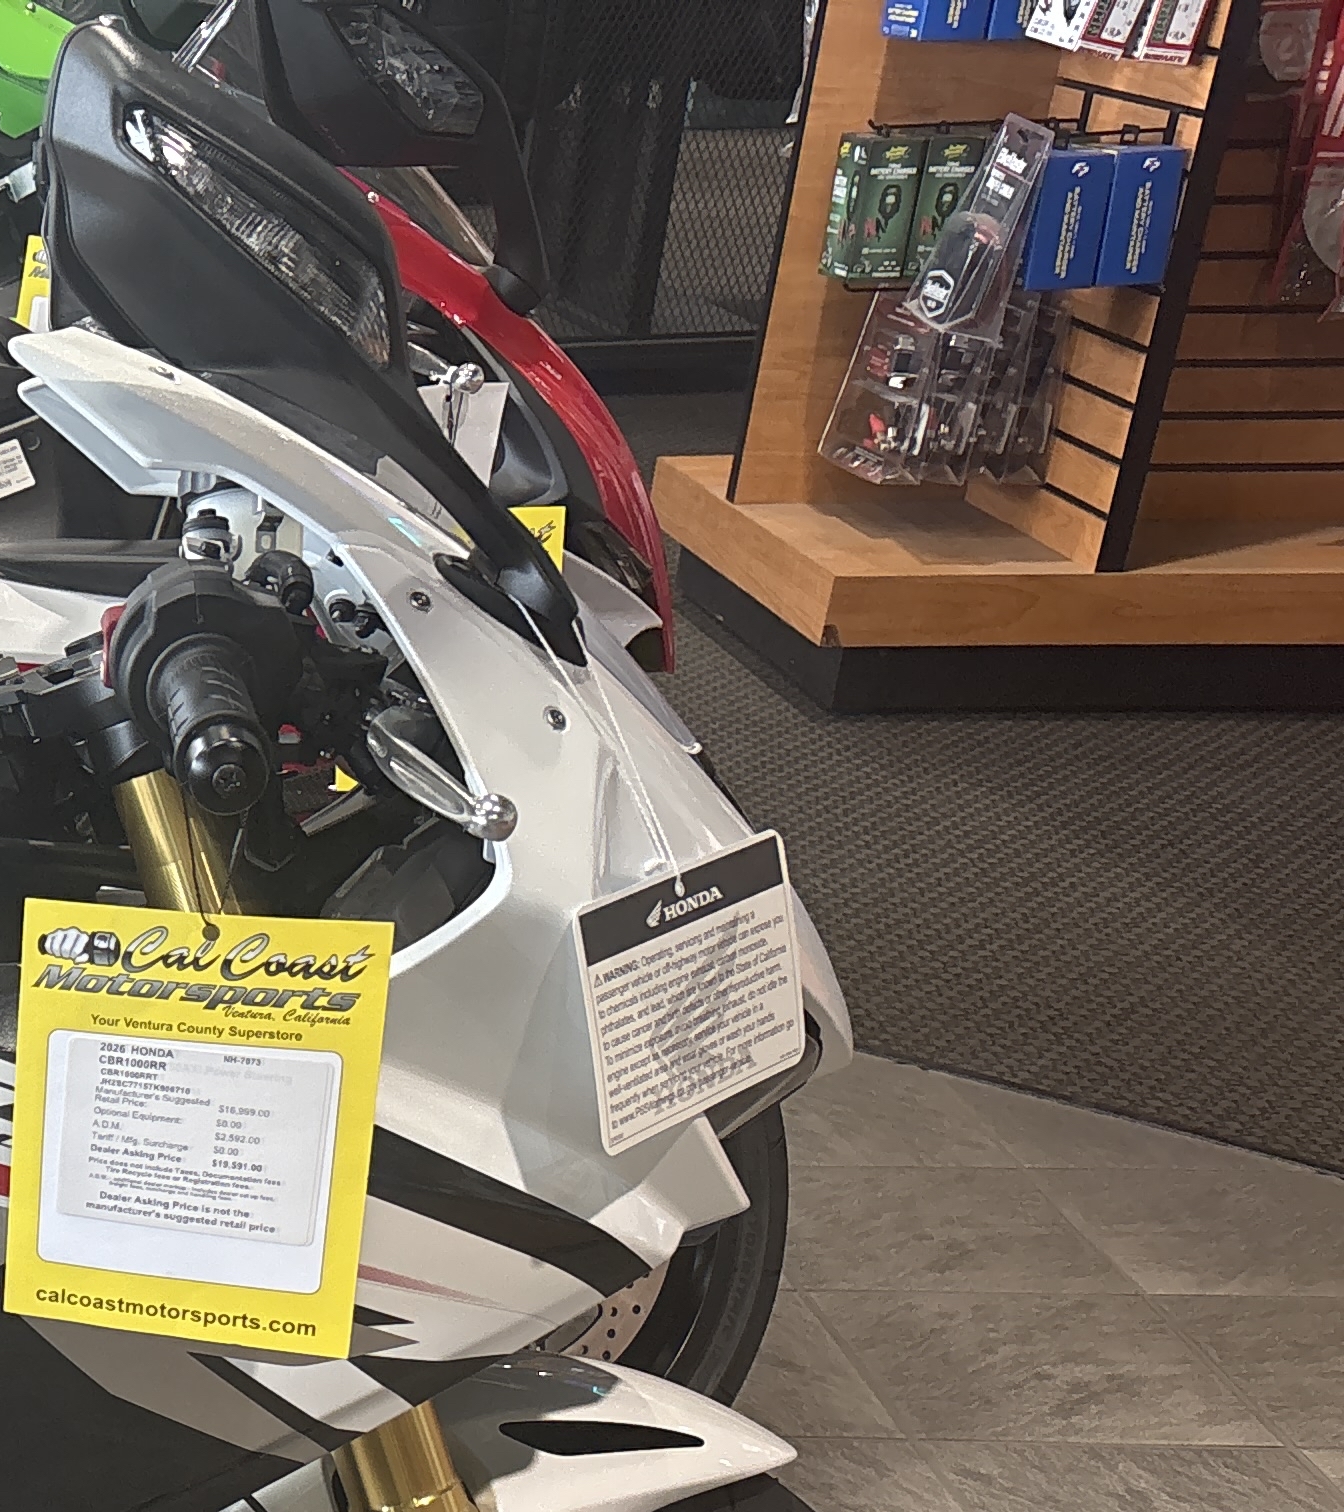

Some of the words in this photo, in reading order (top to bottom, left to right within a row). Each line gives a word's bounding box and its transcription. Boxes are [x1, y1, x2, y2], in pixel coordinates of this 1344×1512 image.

[663, 886, 724, 922] HONDA
[121, 926, 220, 974] Cal
[221, 932, 375, 982] Coast
[32, 962, 361, 1013] Motorsports
[595, 982, 630, 1005] passenger
[639, 983, 667, 1003] including
[283, 1008, 351, 1027] California
[91, 1013, 118, 1030] Your
[123, 1016, 173, 1033] Ventura
[177, 1021, 225, 1039] County
[228, 1024, 302, 1043] Superstore
[610, 1034, 630, 1048] cause
[631, 1024, 652, 1038] cancer
[99, 1042, 125, 1053] 2026
[130, 1045, 174, 1058] HONDA
[98, 1055, 166, 1070] CBR1000RR
[94, 1094, 119, 1104] Retail
[161, 1094, 210, 1107] Suggested
[93, 1106, 130, 1118] Optional
[215, 1119, 241, 1129] $0.00
[90, 1143, 119, 1154] Dealer
[122, 1147, 154, 1160] Asking
[157, 1153, 181, 1162] Price
[142, 1138, 188, 1152] Surcharge
[213, 1146, 239, 1156] $0.00
[88, 1156, 107, 1165] Price
[109, 1158, 128, 1167] does
[144, 1163, 173, 1173] include
[105, 1166, 120, 1174] Tire
[121, 1168, 152, 1179] Recycle
[99, 1190, 131, 1202] Dealer
[133, 1196, 169, 1210] Asking
[172, 1201, 198, 1212] Price
[200, 1205, 210, 1213] is
[212, 1206, 230, 1216] not
[233, 1208, 249, 1218] the
[85, 1201, 160, 1219] manufacturer's
[163, 1212, 217, 1227] suggested
[219, 1218, 245, 1229] retail
[248, 1223, 275, 1234] price
[36, 1286, 317, 1337] calcoastmotorsports.com
